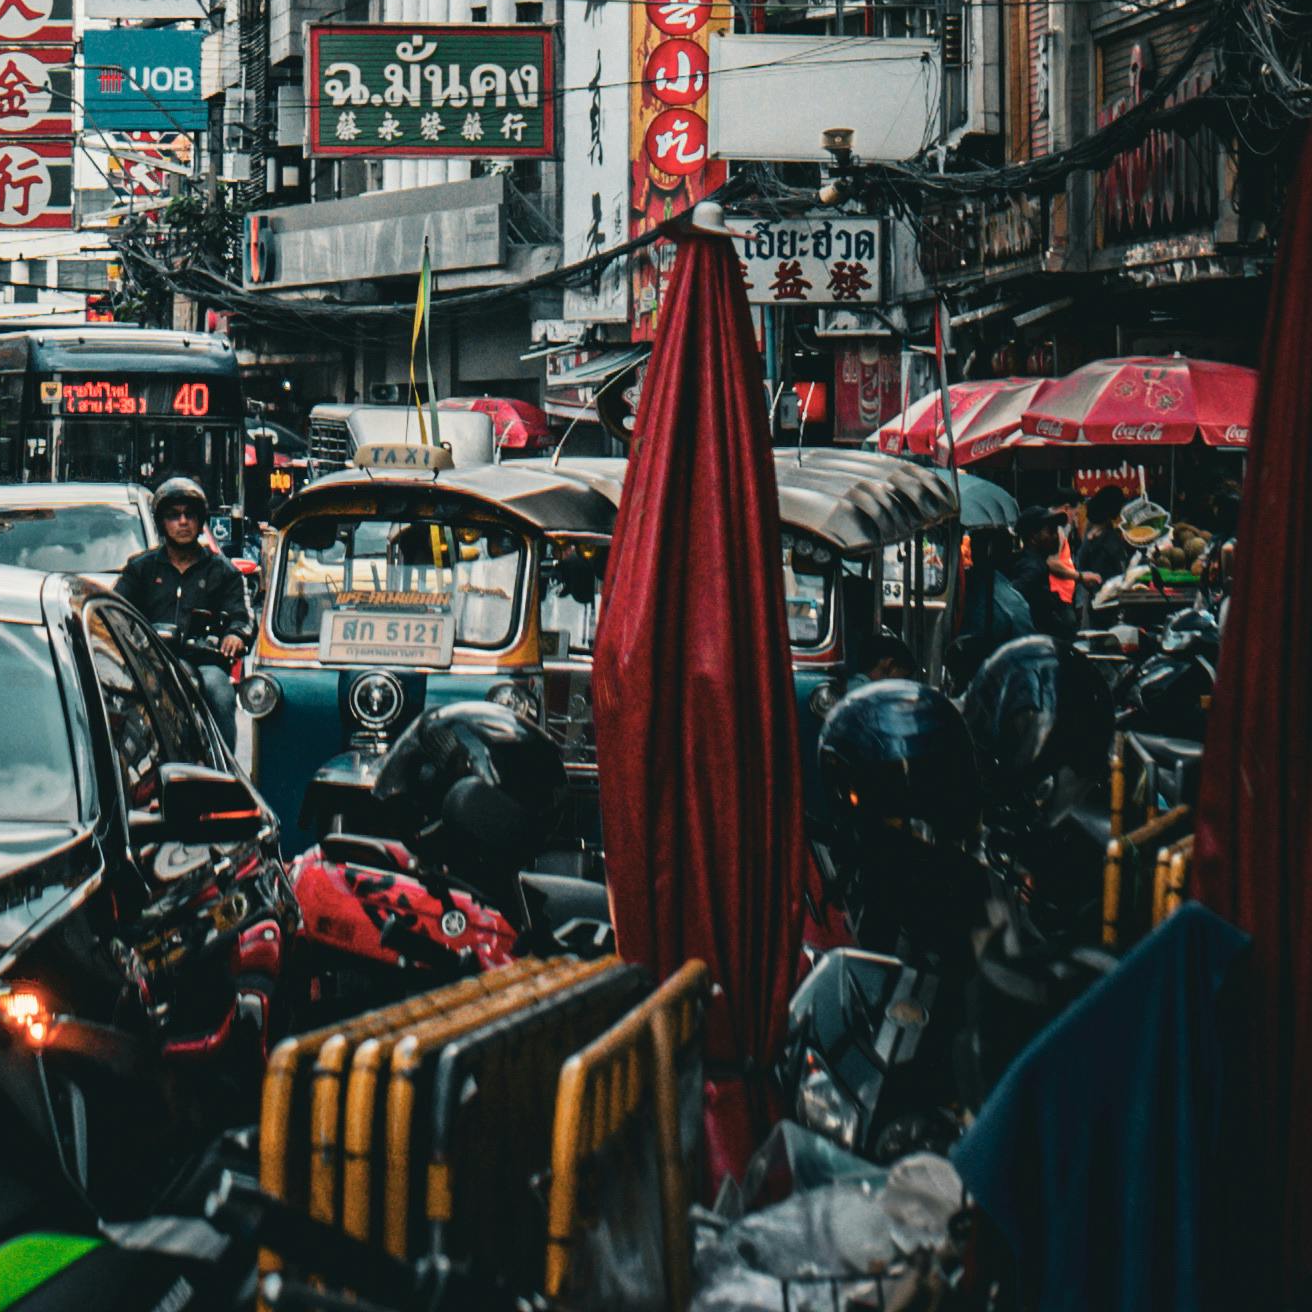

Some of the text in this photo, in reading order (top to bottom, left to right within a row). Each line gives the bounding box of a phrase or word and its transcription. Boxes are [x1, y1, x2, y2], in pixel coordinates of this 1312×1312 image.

[129, 67, 195, 92] UOB
[323, 34, 539, 108] ฉ.มั่นคง
[739, 259, 874, 301] 益發
[173, 382, 210, 417] 40
[370, 447, 431, 465] TAXI
[342, 618, 439, 644] สก 5121
